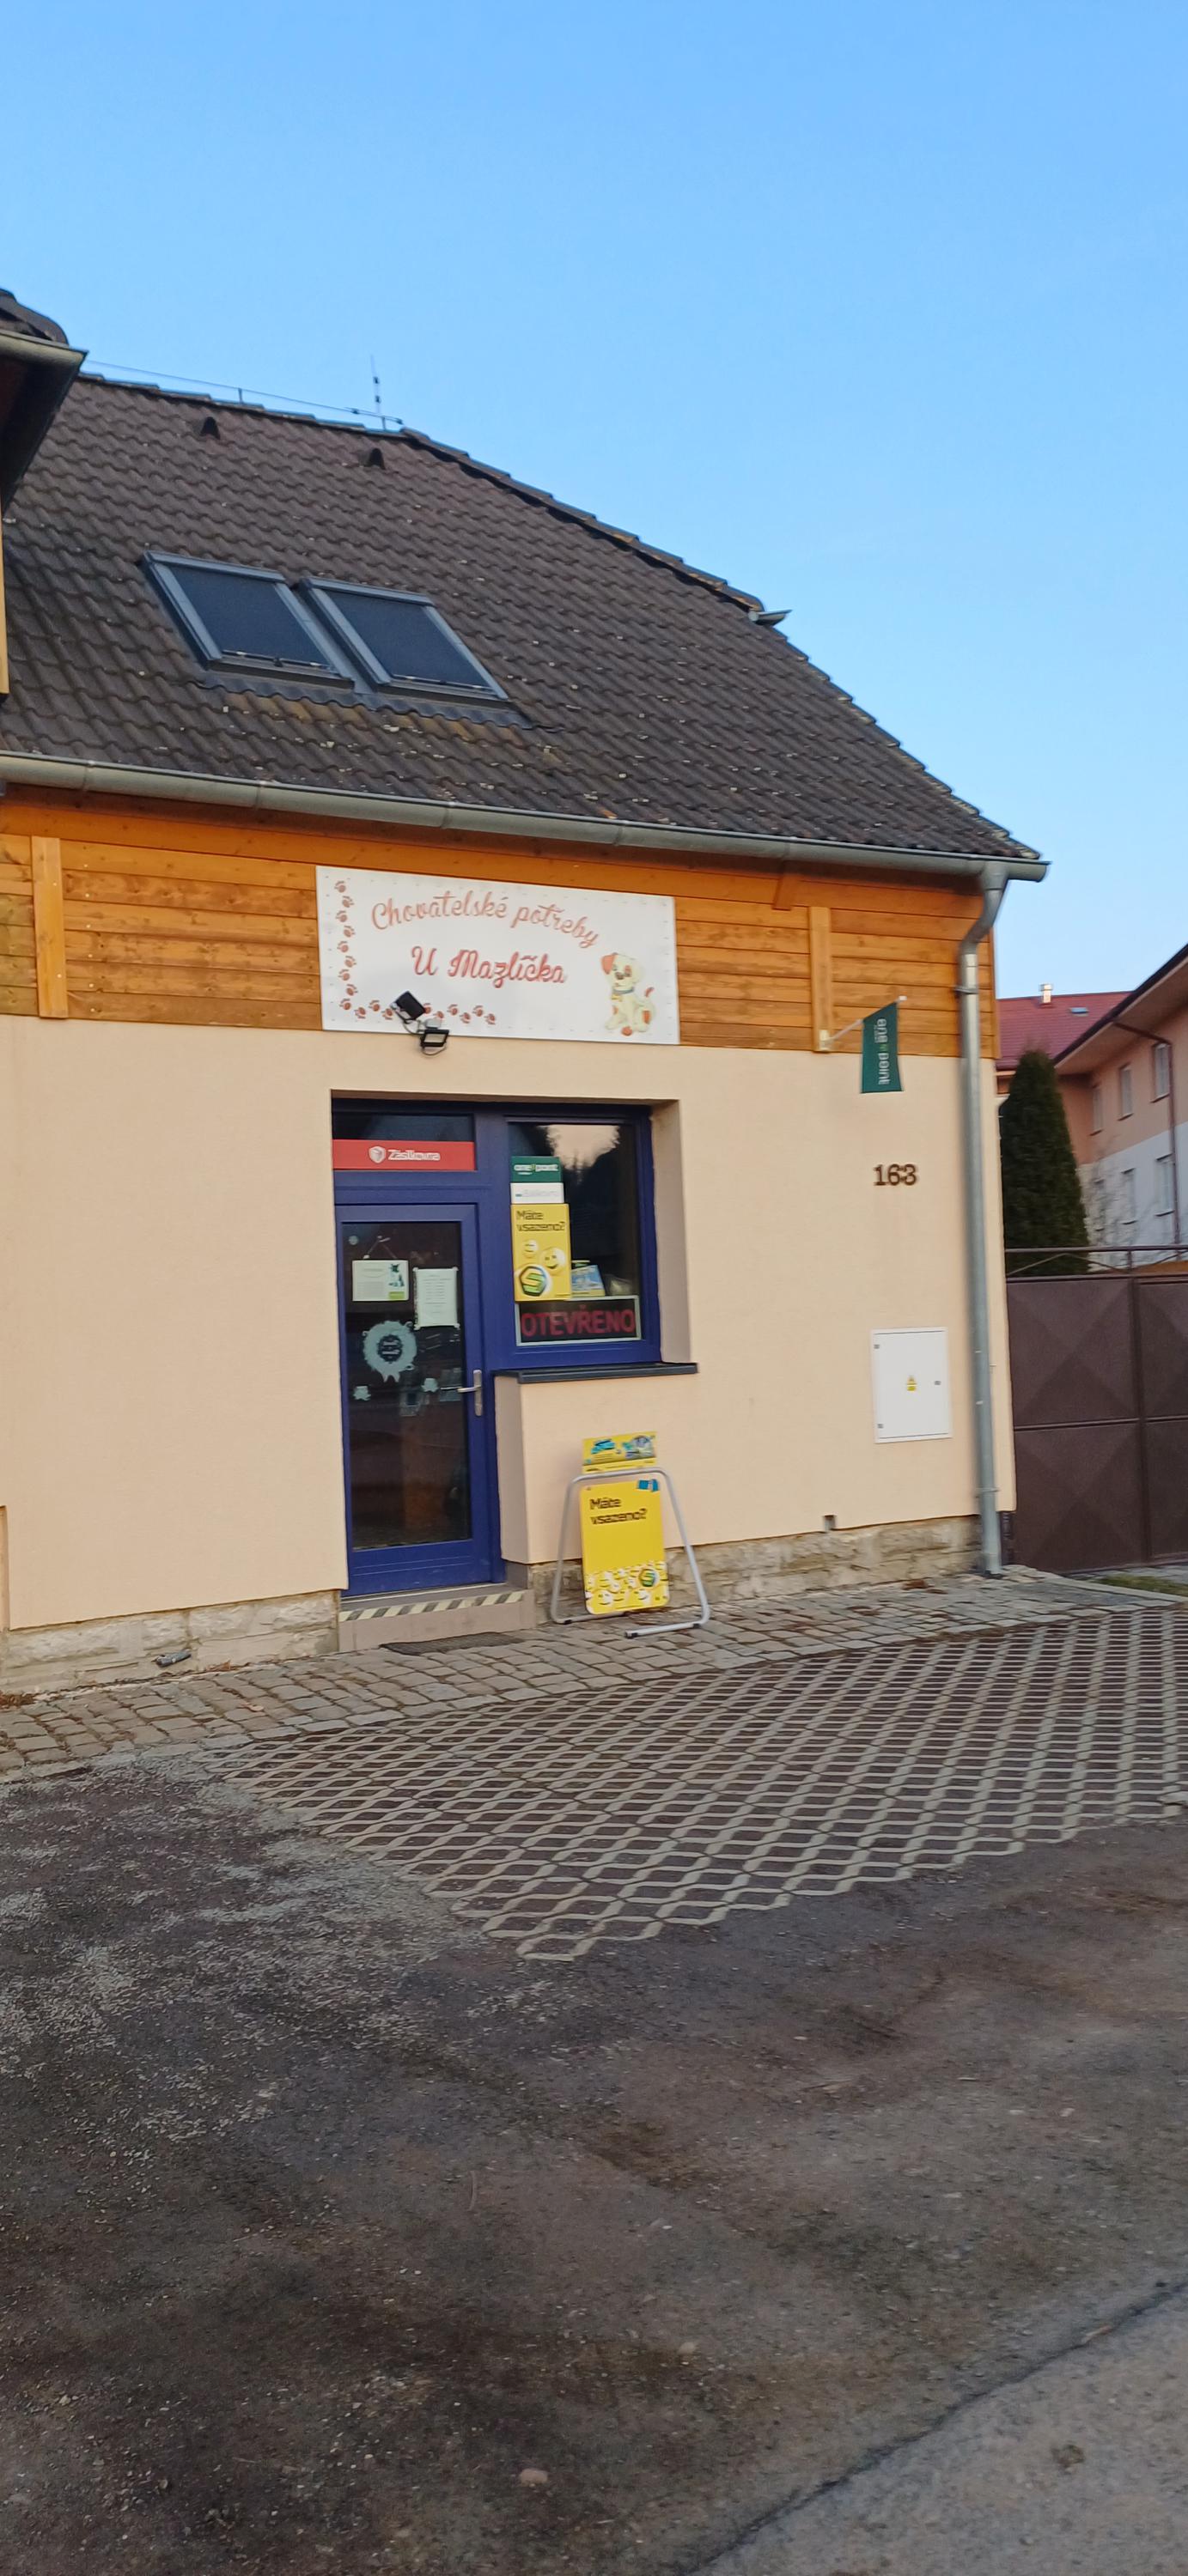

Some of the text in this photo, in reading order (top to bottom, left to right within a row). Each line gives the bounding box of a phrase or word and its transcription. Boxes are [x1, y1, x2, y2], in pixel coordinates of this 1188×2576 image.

[370, 890, 600, 948] Chovatelské potřeby
[411, 945, 568, 988] U Mazlíčka
[874, 1163, 917, 1186] 163
[520, 1304, 637, 1337] OTEVŘENO
[589, 1497, 622, 1510] Máte
[590, 1508, 648, 1525] vsazeno?
